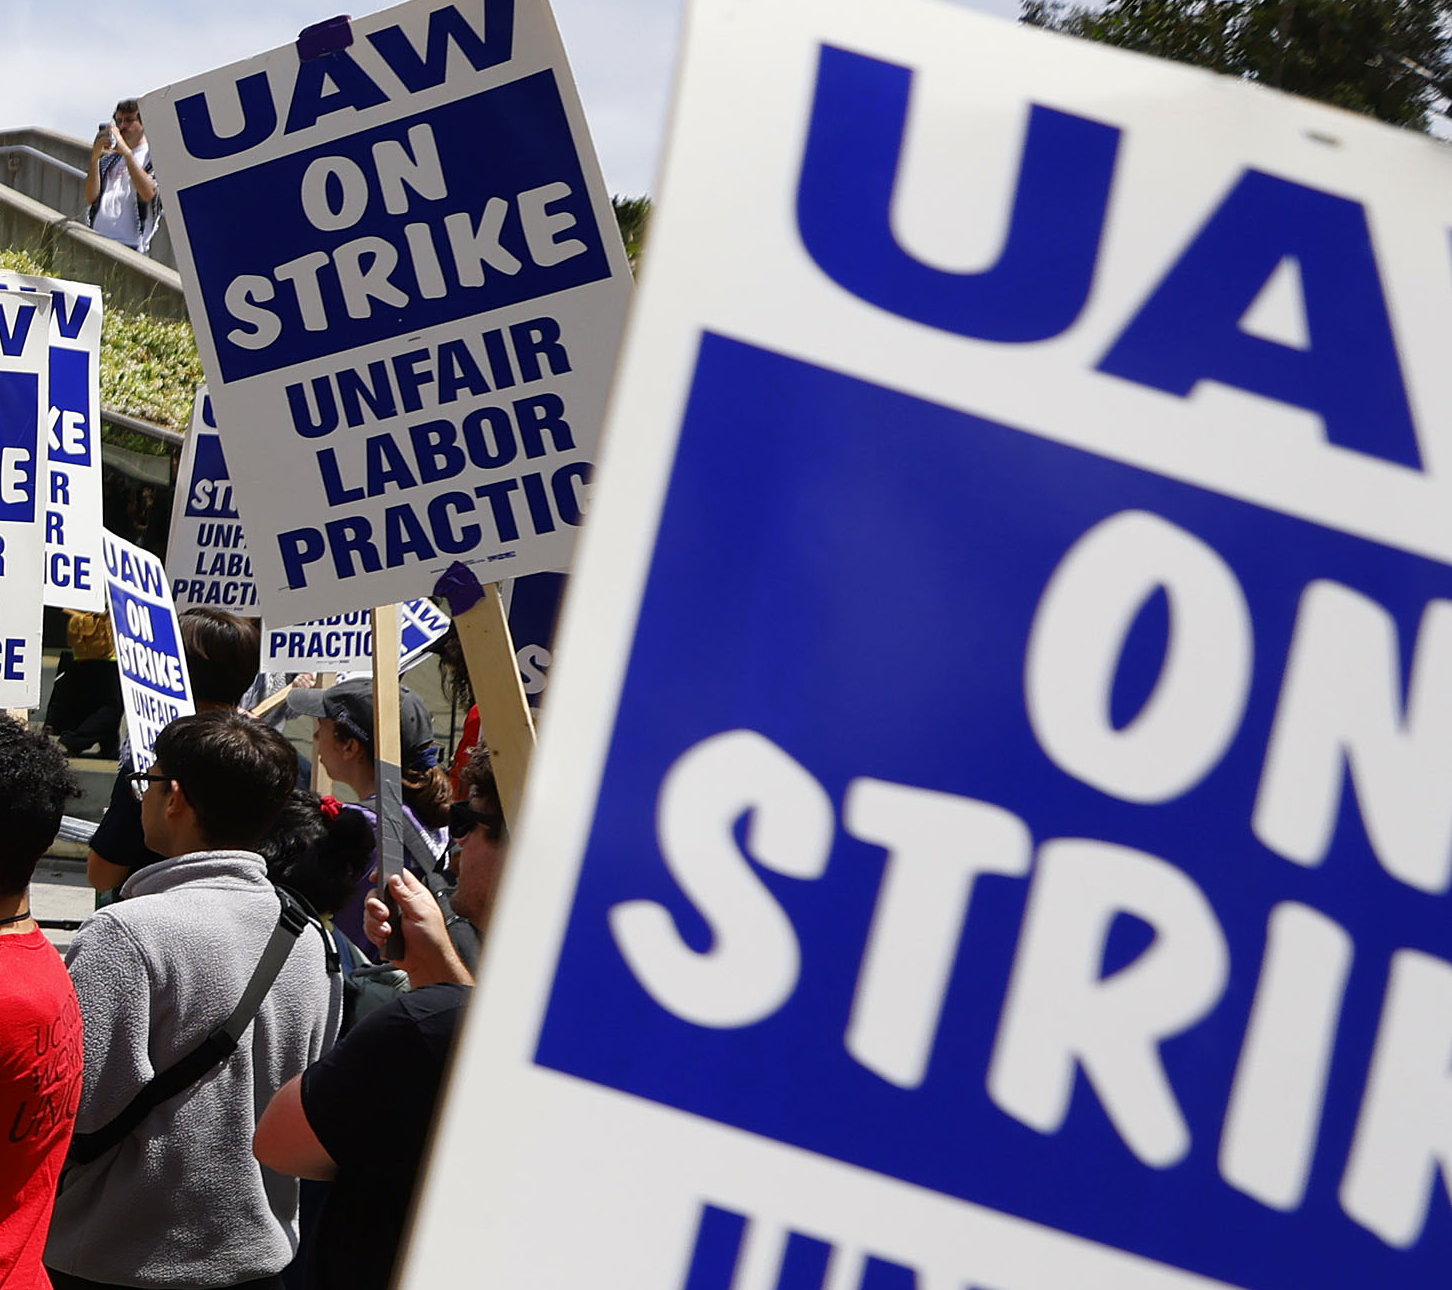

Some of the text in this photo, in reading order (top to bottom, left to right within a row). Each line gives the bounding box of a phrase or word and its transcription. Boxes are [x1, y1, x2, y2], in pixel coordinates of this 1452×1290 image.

[301, 122, 446, 232] ON
[224, 180, 588, 352] STRIKE
[793, 41, 1452, 476] UA
[284, 315, 572, 440] UNFAIR
[315, 391, 578, 508] LABOR
[277, 461, 597, 591] PRACTIC
[119, 633, 184, 692] STRIKE
[126, 599, 154, 643] ON
[608, 728, 1452, 1247] STRI
